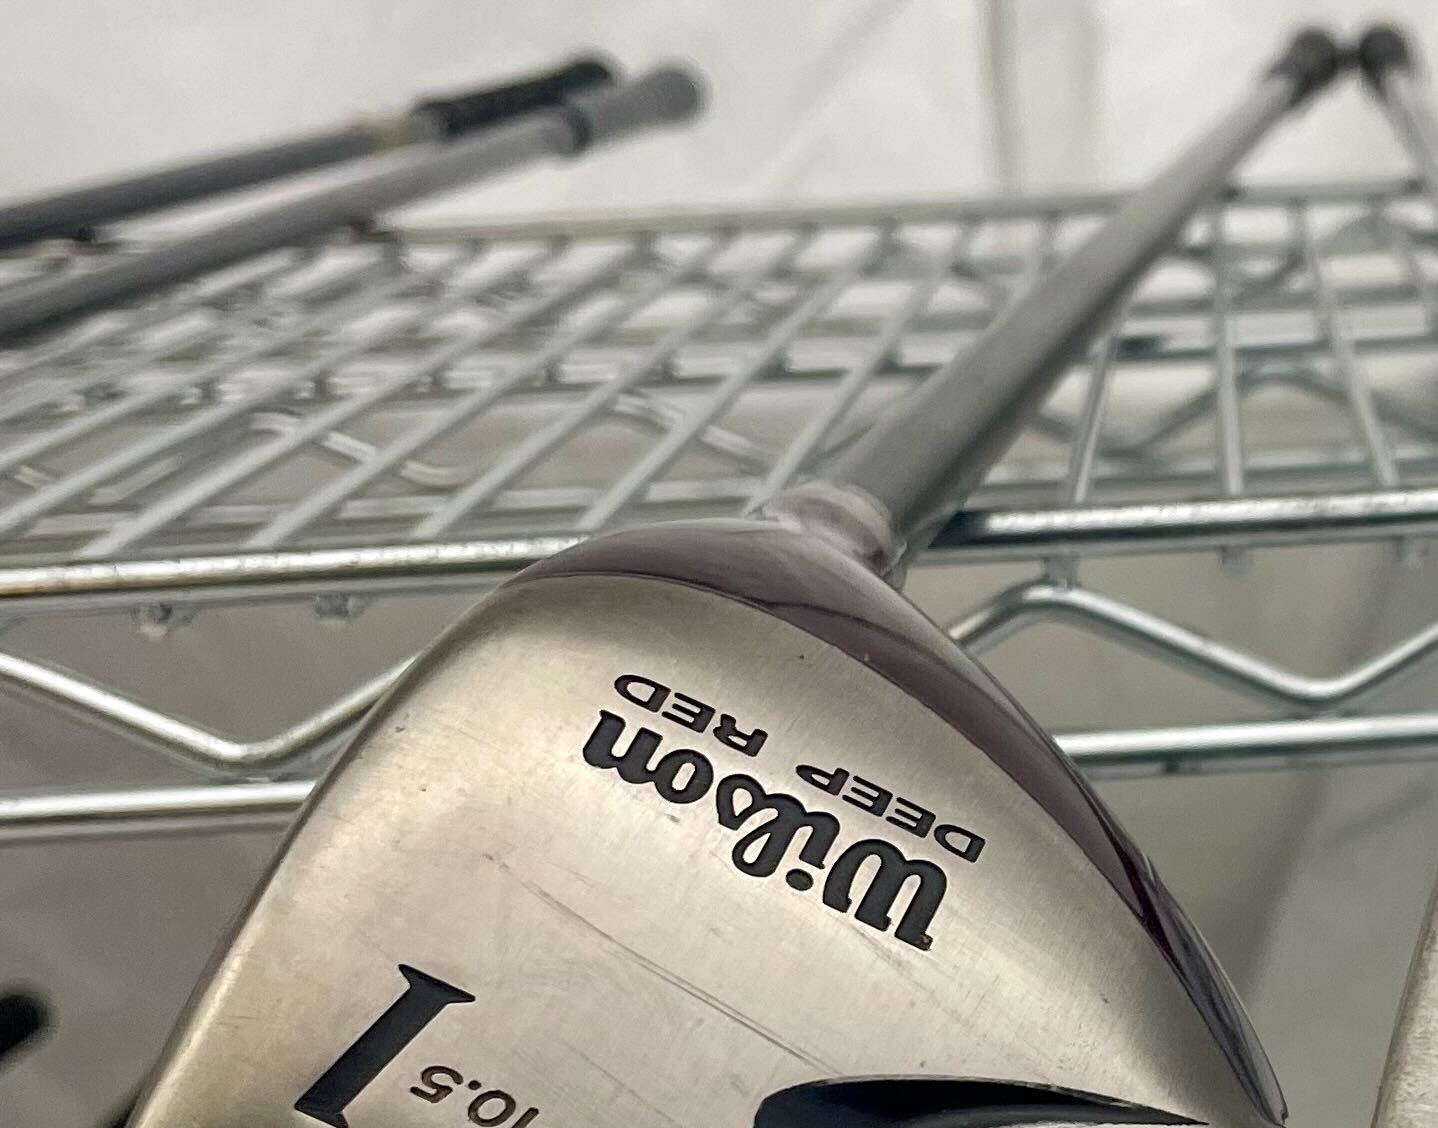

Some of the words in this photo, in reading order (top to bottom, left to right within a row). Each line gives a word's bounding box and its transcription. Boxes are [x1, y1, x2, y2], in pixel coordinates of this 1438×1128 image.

[614, 674, 768, 757] RED
[582, 710, 947, 951] Wilson
[796, 764, 986, 863] DEEP
